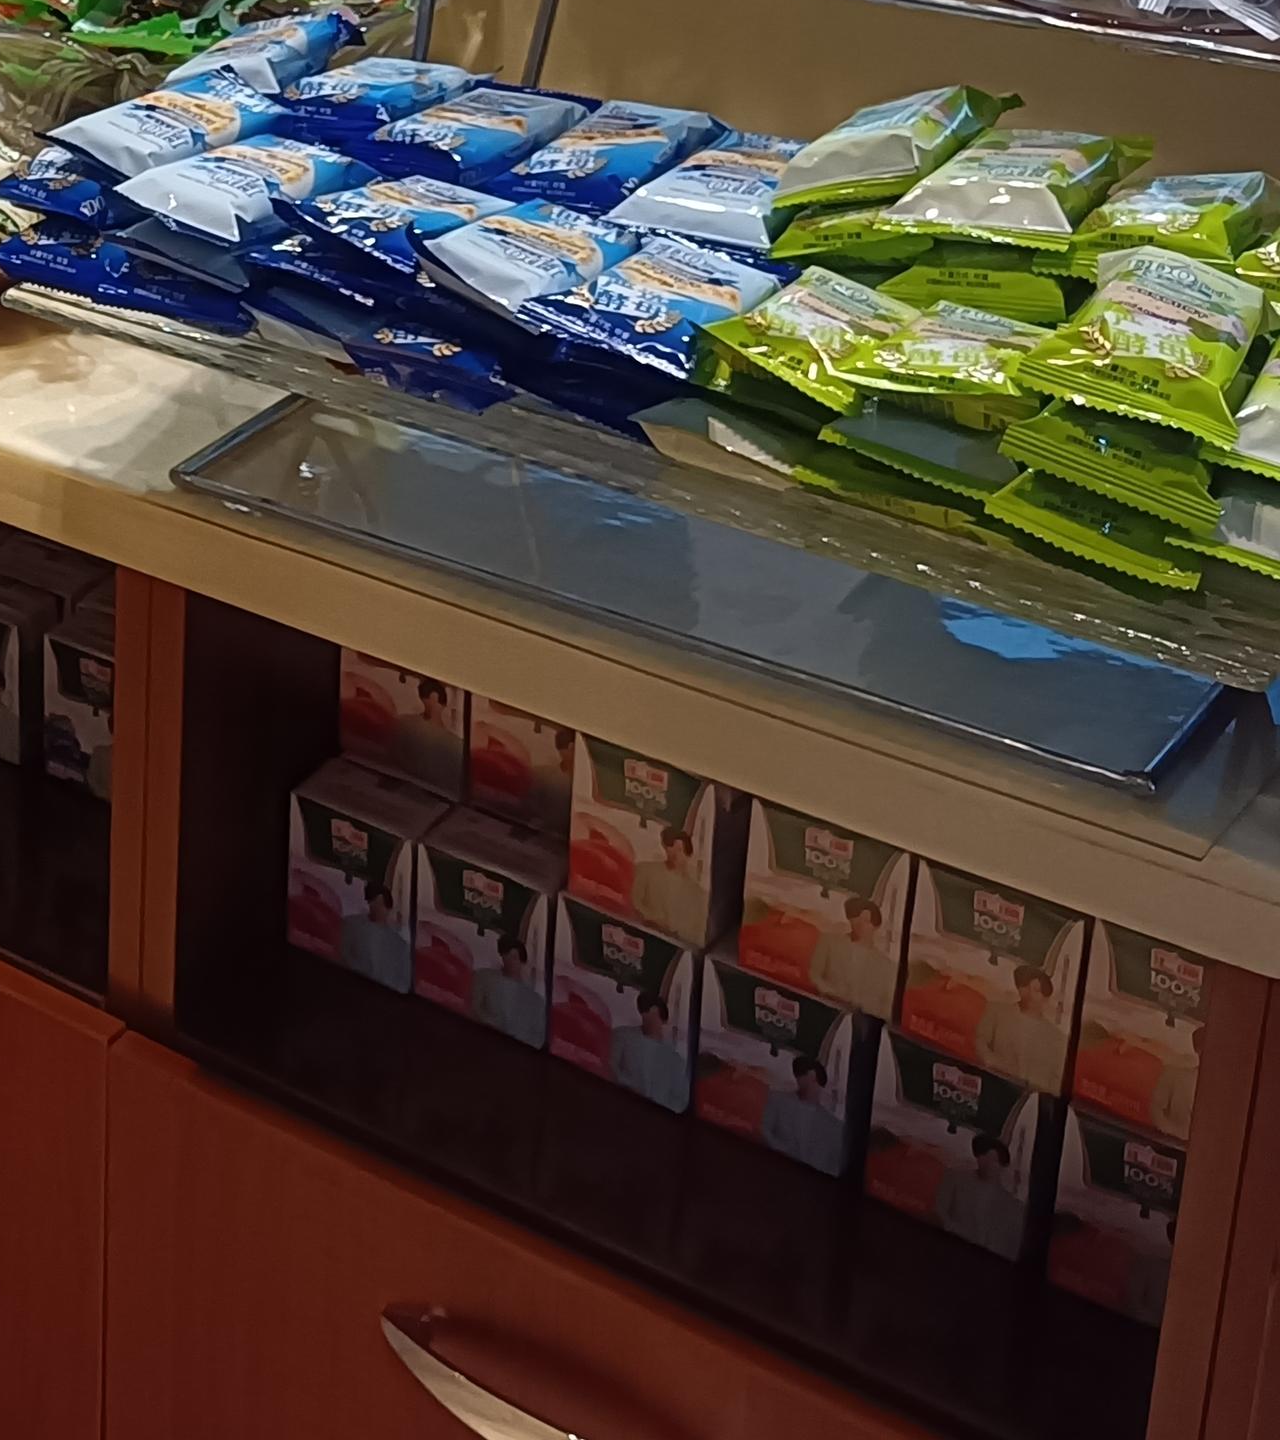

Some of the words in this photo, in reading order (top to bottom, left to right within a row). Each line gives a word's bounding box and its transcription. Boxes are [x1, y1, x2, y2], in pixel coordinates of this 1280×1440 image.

[973, 910, 1021, 942] 100%
[1149, 968, 1202, 1002] 100%
[933, 1081, 979, 1115] 100%
